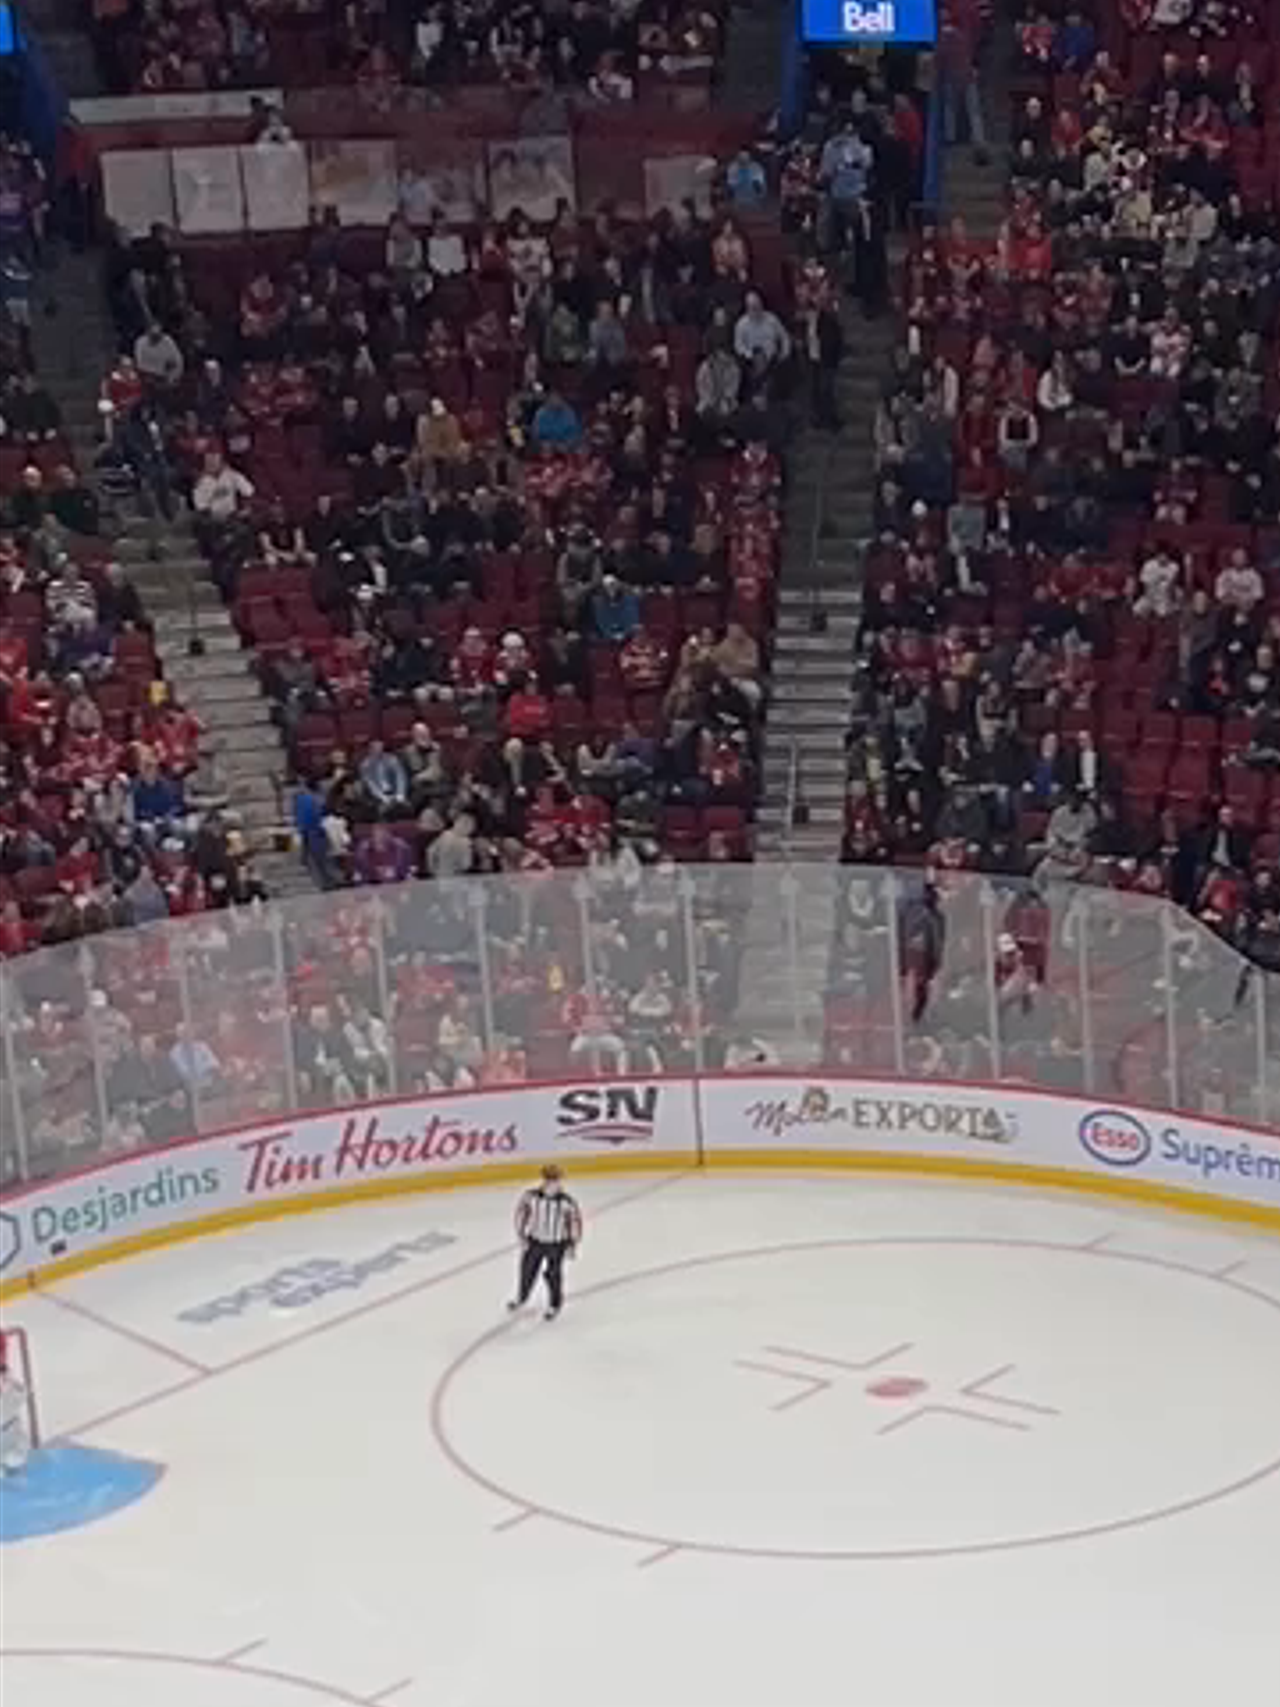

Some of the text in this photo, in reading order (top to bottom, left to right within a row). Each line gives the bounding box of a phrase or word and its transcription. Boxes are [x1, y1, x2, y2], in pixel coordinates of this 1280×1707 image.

[841, 0, 894, 35] Bell
[238, 1115, 518, 1192] Tim Hortons
[33, 1162, 220, 1244] Desjardins
